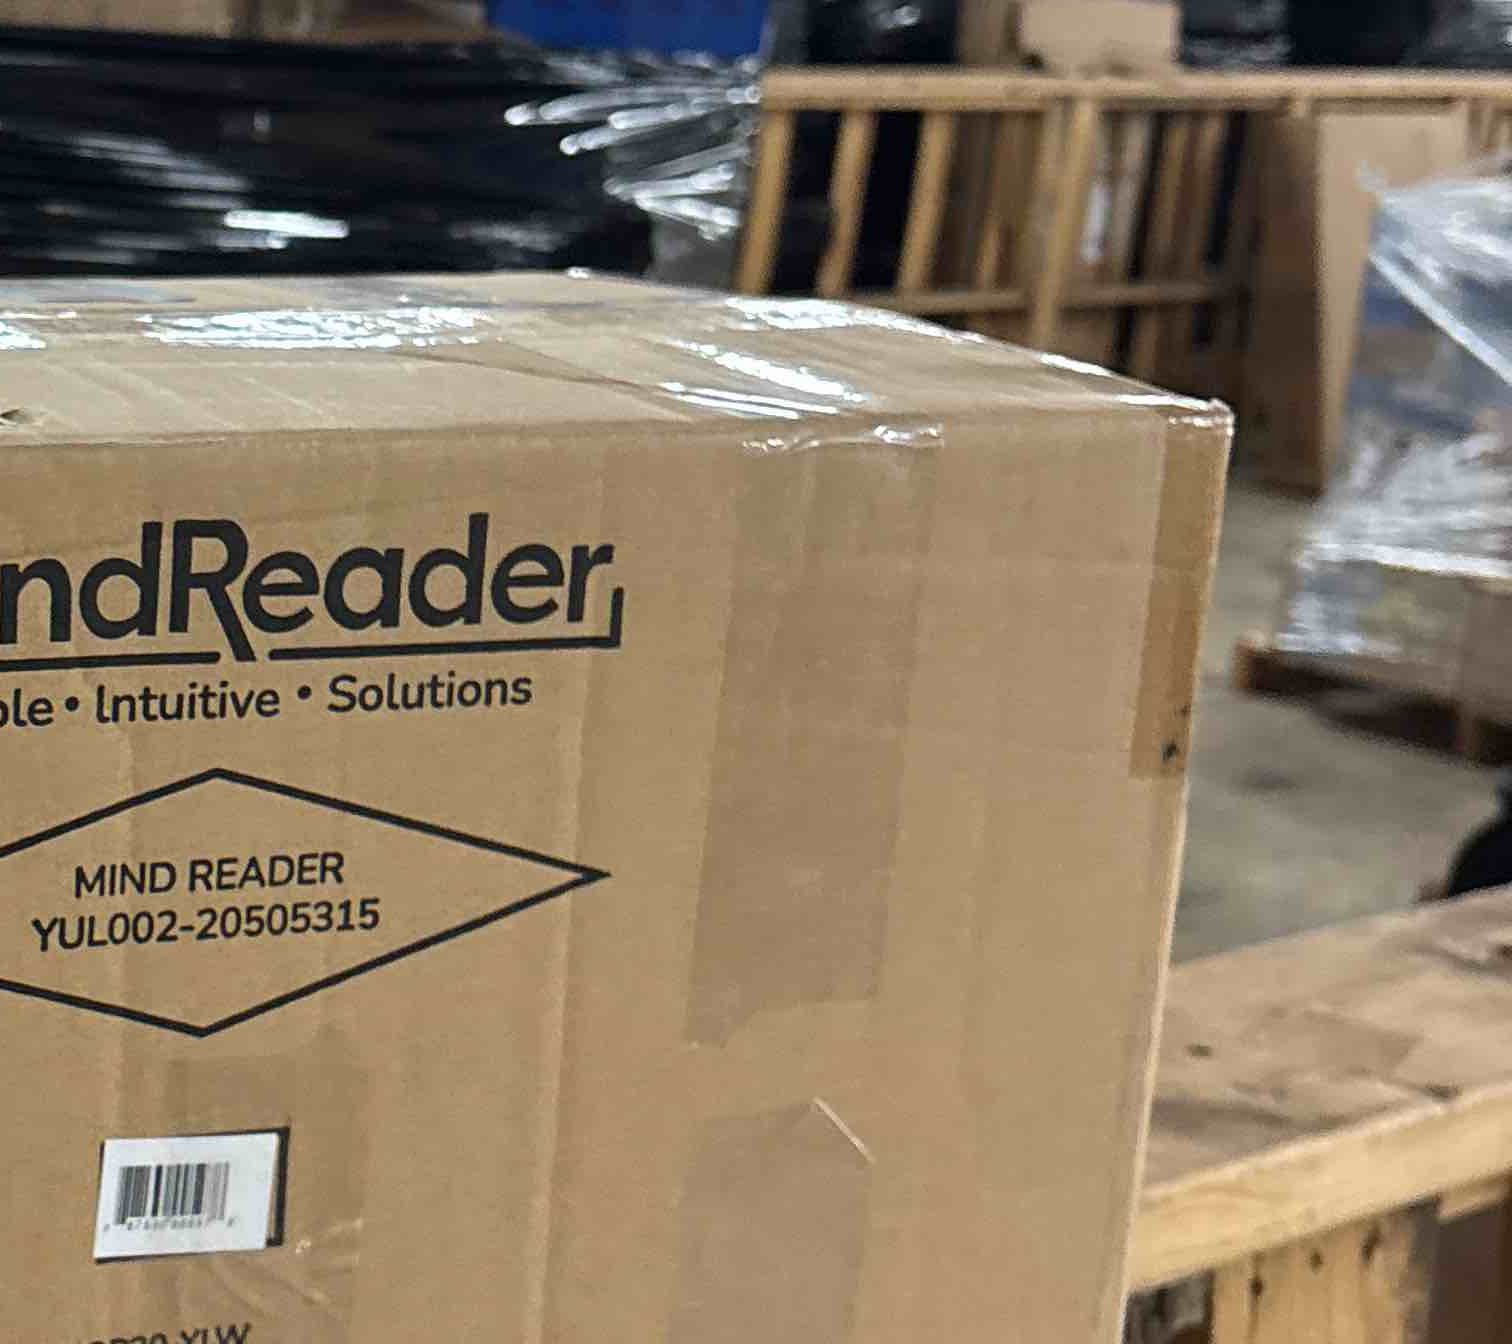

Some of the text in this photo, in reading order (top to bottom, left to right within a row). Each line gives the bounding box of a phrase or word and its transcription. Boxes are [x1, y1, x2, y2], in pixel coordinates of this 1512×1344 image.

[327, 669, 533, 714] Solutions
[74, 850, 345, 900] MIND READER
[30, 896, 381, 953] YUL002-20505315
